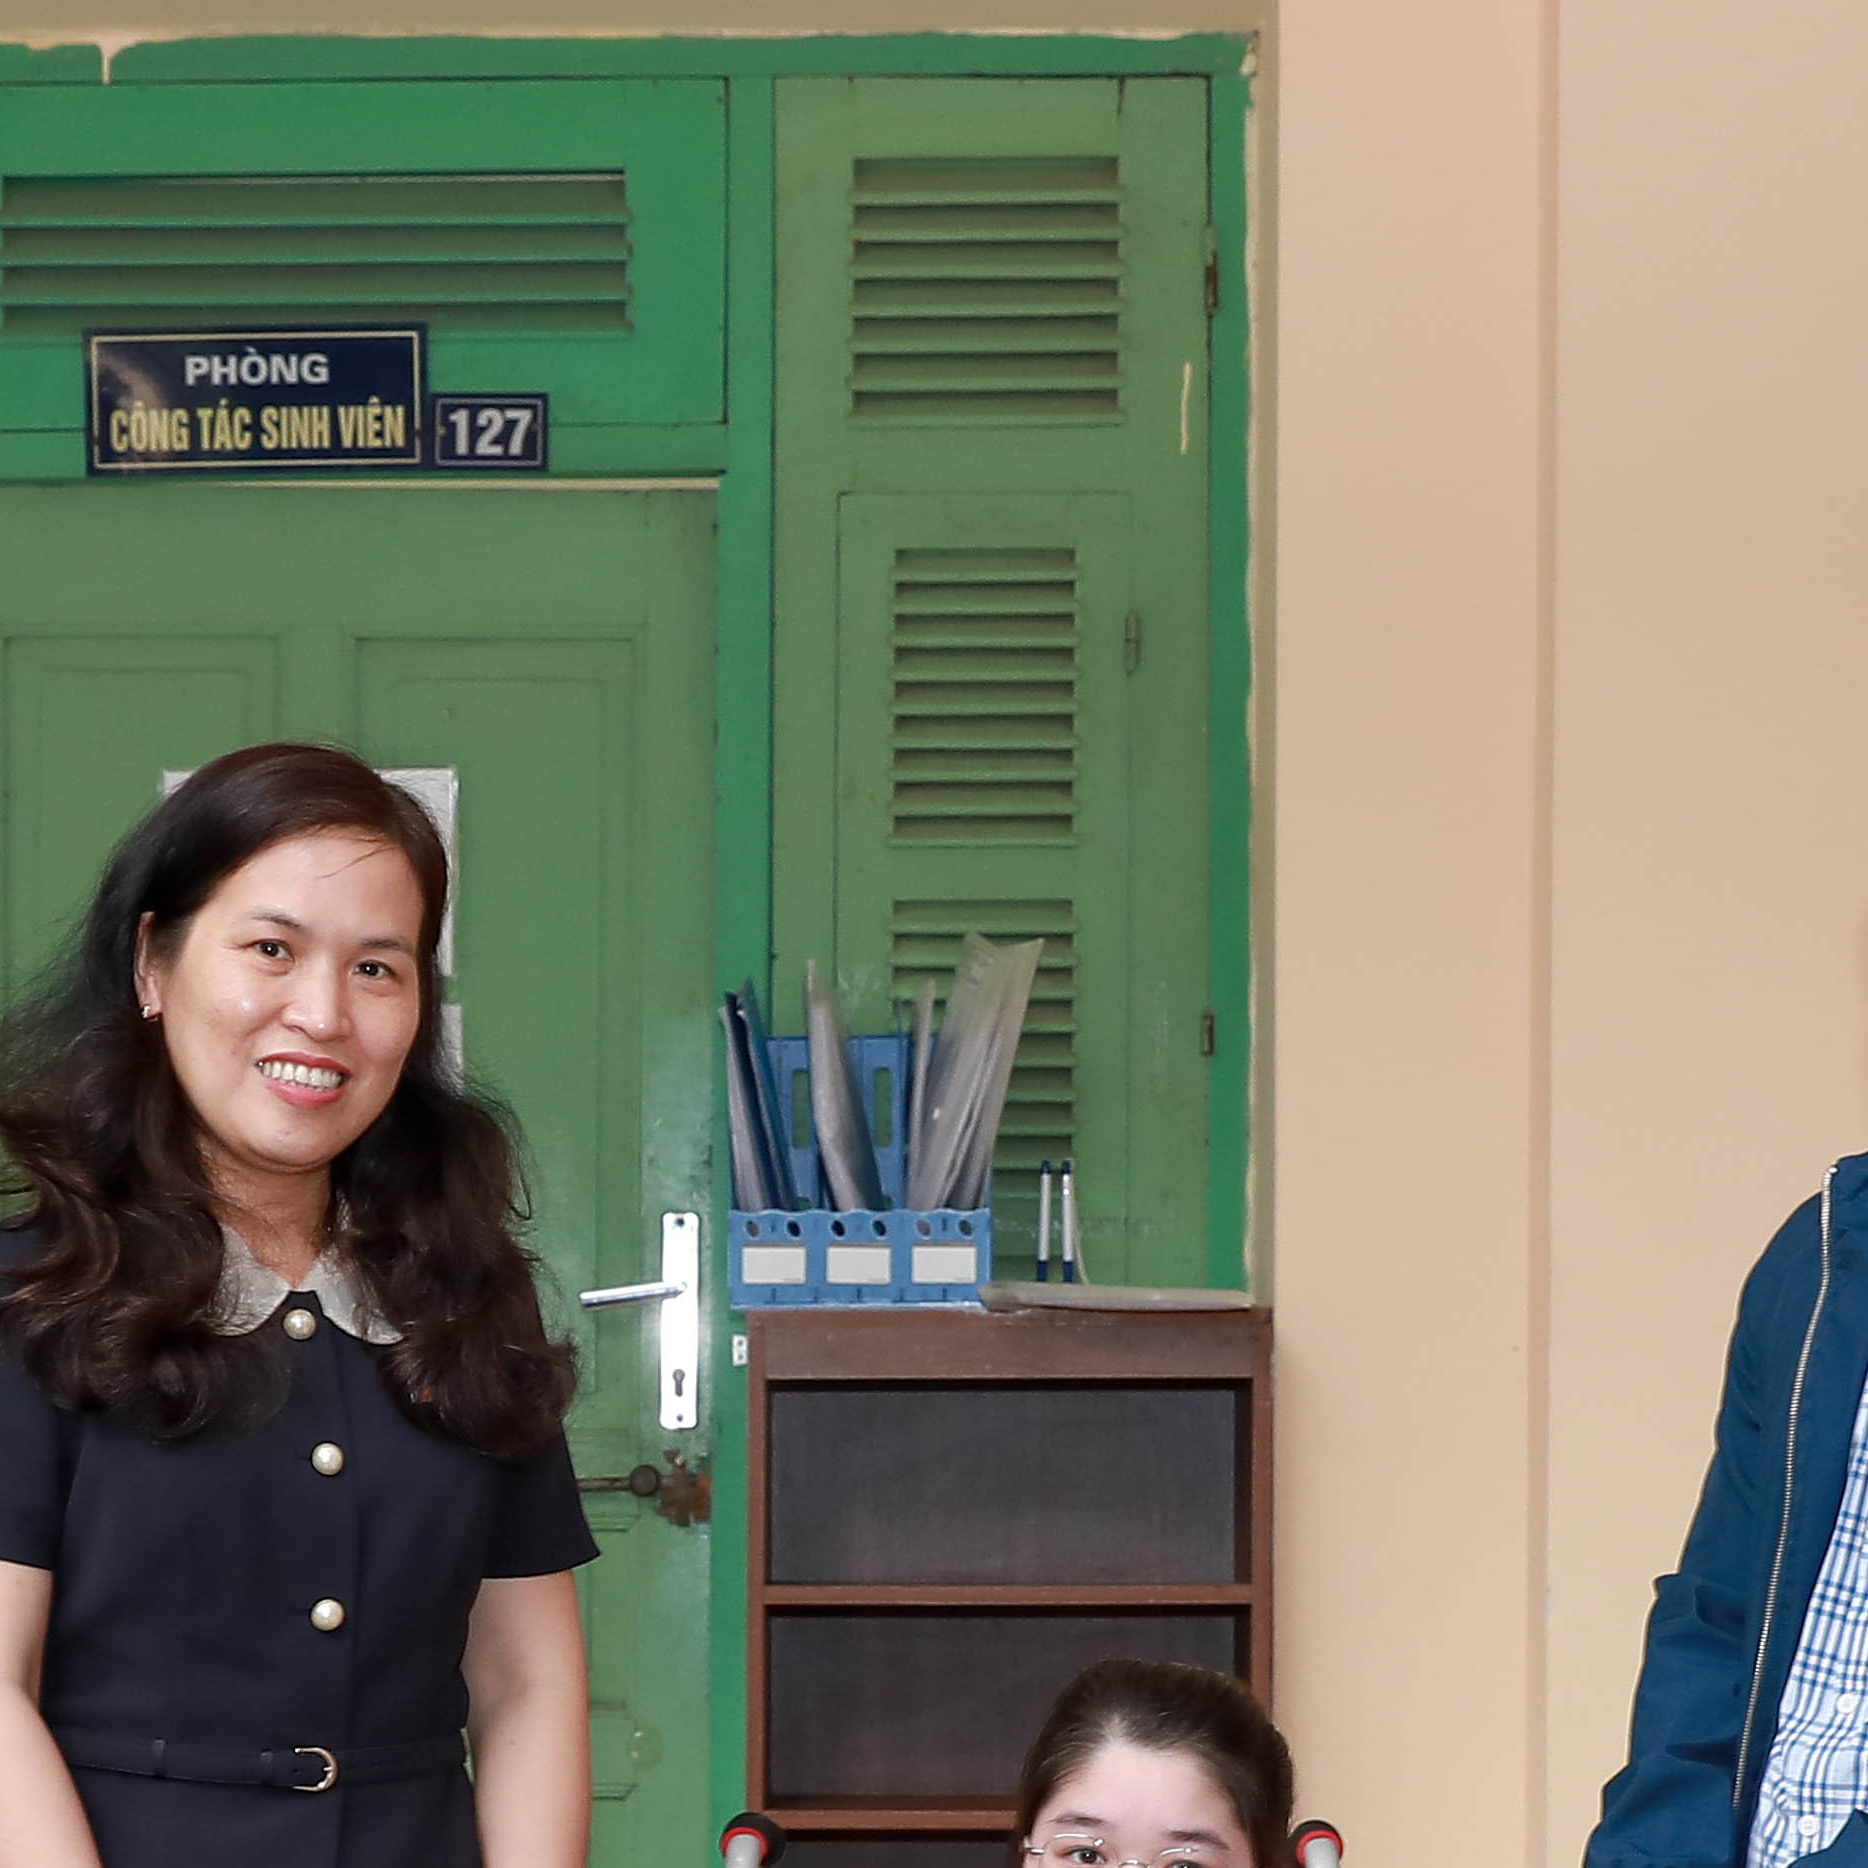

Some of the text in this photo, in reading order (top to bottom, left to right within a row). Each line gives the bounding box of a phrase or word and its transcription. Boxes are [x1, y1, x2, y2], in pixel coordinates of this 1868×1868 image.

[185, 346, 329, 386] PHÒNG
[110, 396, 405, 452] CÔNG TÁC SINH VIÊN
[448, 407, 532, 456] 127
